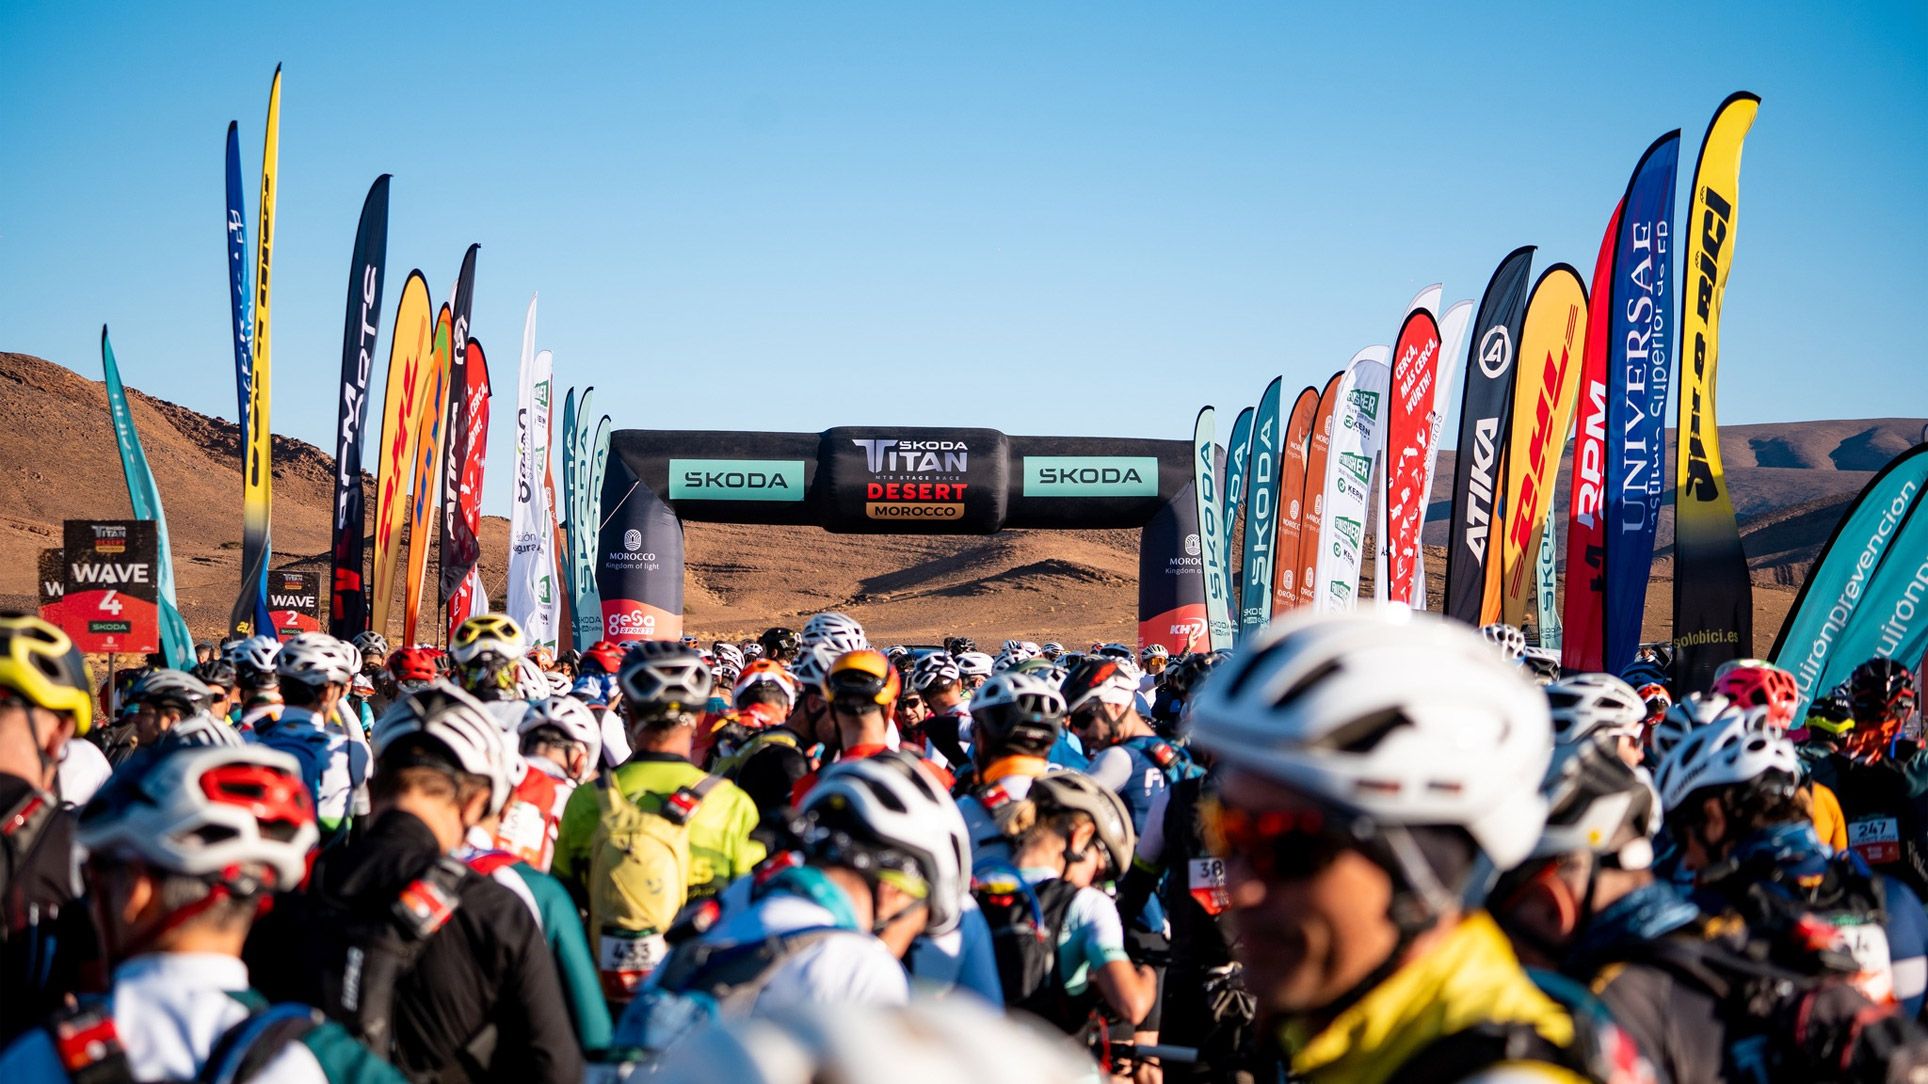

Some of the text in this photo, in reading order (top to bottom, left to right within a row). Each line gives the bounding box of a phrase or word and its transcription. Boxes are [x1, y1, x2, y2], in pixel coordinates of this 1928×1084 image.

[1395, 344, 1418, 380] CERCA,
[1400, 337, 1438, 399] MÁS CERCA,
[1622, 221, 1652, 535] UNIVERSAE
[852, 439, 968, 473] TITAN
[1510, 343, 1569, 558] DHL
[1577, 379, 1607, 531] RPM
[867, 483, 968, 500] DESERT
[1466, 417, 1499, 568] ATIKA
[875, 505, 957, 517] MOROCCO
[605, 561, 660, 571] Kingdom of light
[609, 552, 656, 561] MOROCCO
[72, 563, 149, 583] WAVE
[98, 588, 123, 616] 4
[271, 594, 315, 608] WAVE
[286, 609, 299, 626] 2
[1170, 624, 1201, 635] KH7
[1673, 629, 1739, 648] solobici.es
[1858, 821, 1887, 838] 247
[611, 942, 651, 960] 433
